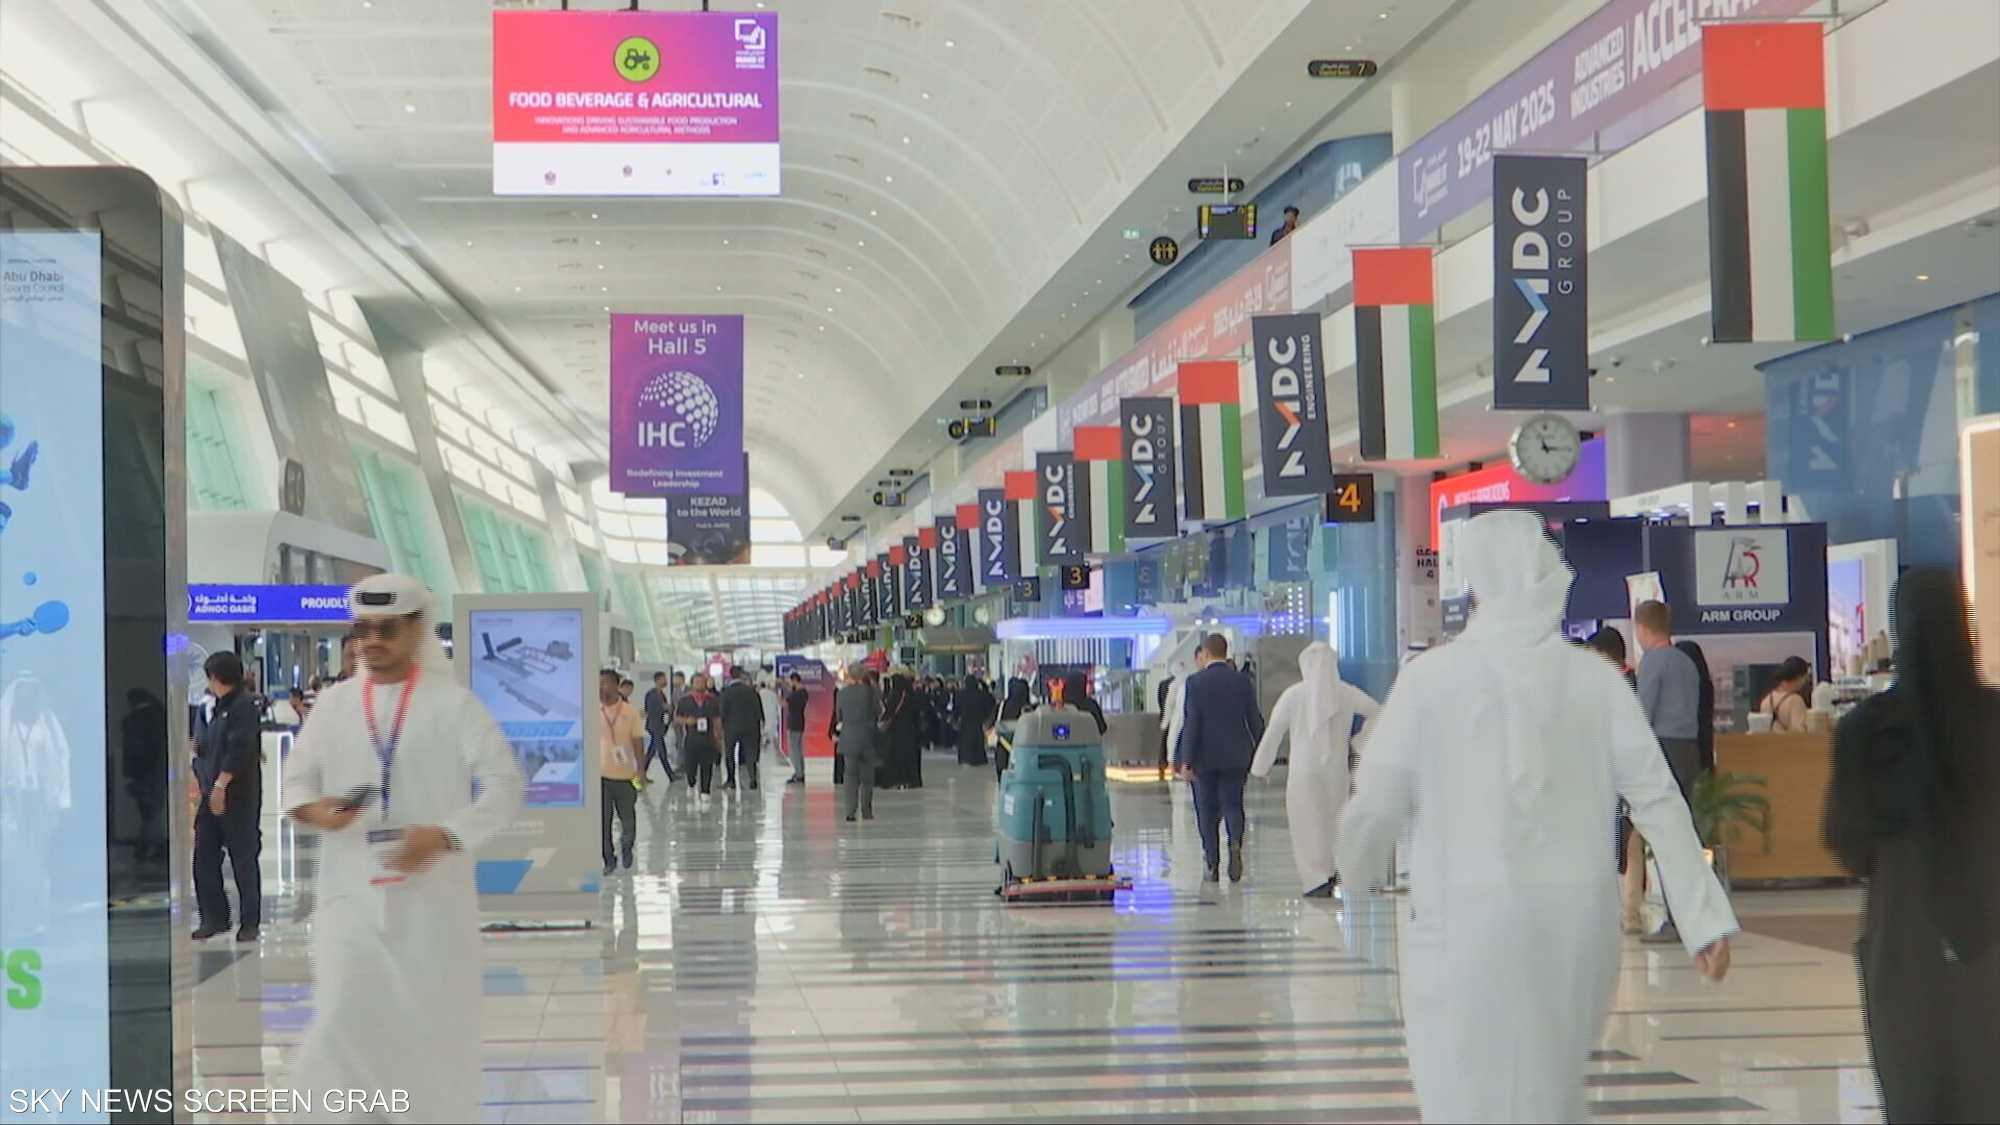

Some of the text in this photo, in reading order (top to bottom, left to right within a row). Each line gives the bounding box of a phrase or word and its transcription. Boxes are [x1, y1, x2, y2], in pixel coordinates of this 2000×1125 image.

[1574, 26, 1625, 85] ADVANCED
[1571, 58, 1625, 120] INDUSTRIES
[509, 92, 762, 110] FOOD BEVERAGE & AGRICULTURAL
[1457, 122, 1491, 179] 19-22
[1493, 101, 1519, 149] MAY
[1520, 79, 1556, 137] 2025
[1558, 188, 1573, 294] GROUP
[3, 271, 64, 281] Abu Dhabi
[634, 320, 717, 334] Meet us in
[649, 338, 707, 355] Hall 5
[1301, 333, 1316, 420] ENGINEERING
[638, 422, 686, 447] IHC
[690, 496, 727, 507] KEZAD
[1339, 483, 1361, 513] 4
[677, 507, 741, 517] to the World
[1071, 566, 1082, 585] 3
[1023, 581, 1032, 597] 3
[195, 604, 228, 614] ADNOC
[1701, 610, 1780, 622] ARM GROUP
